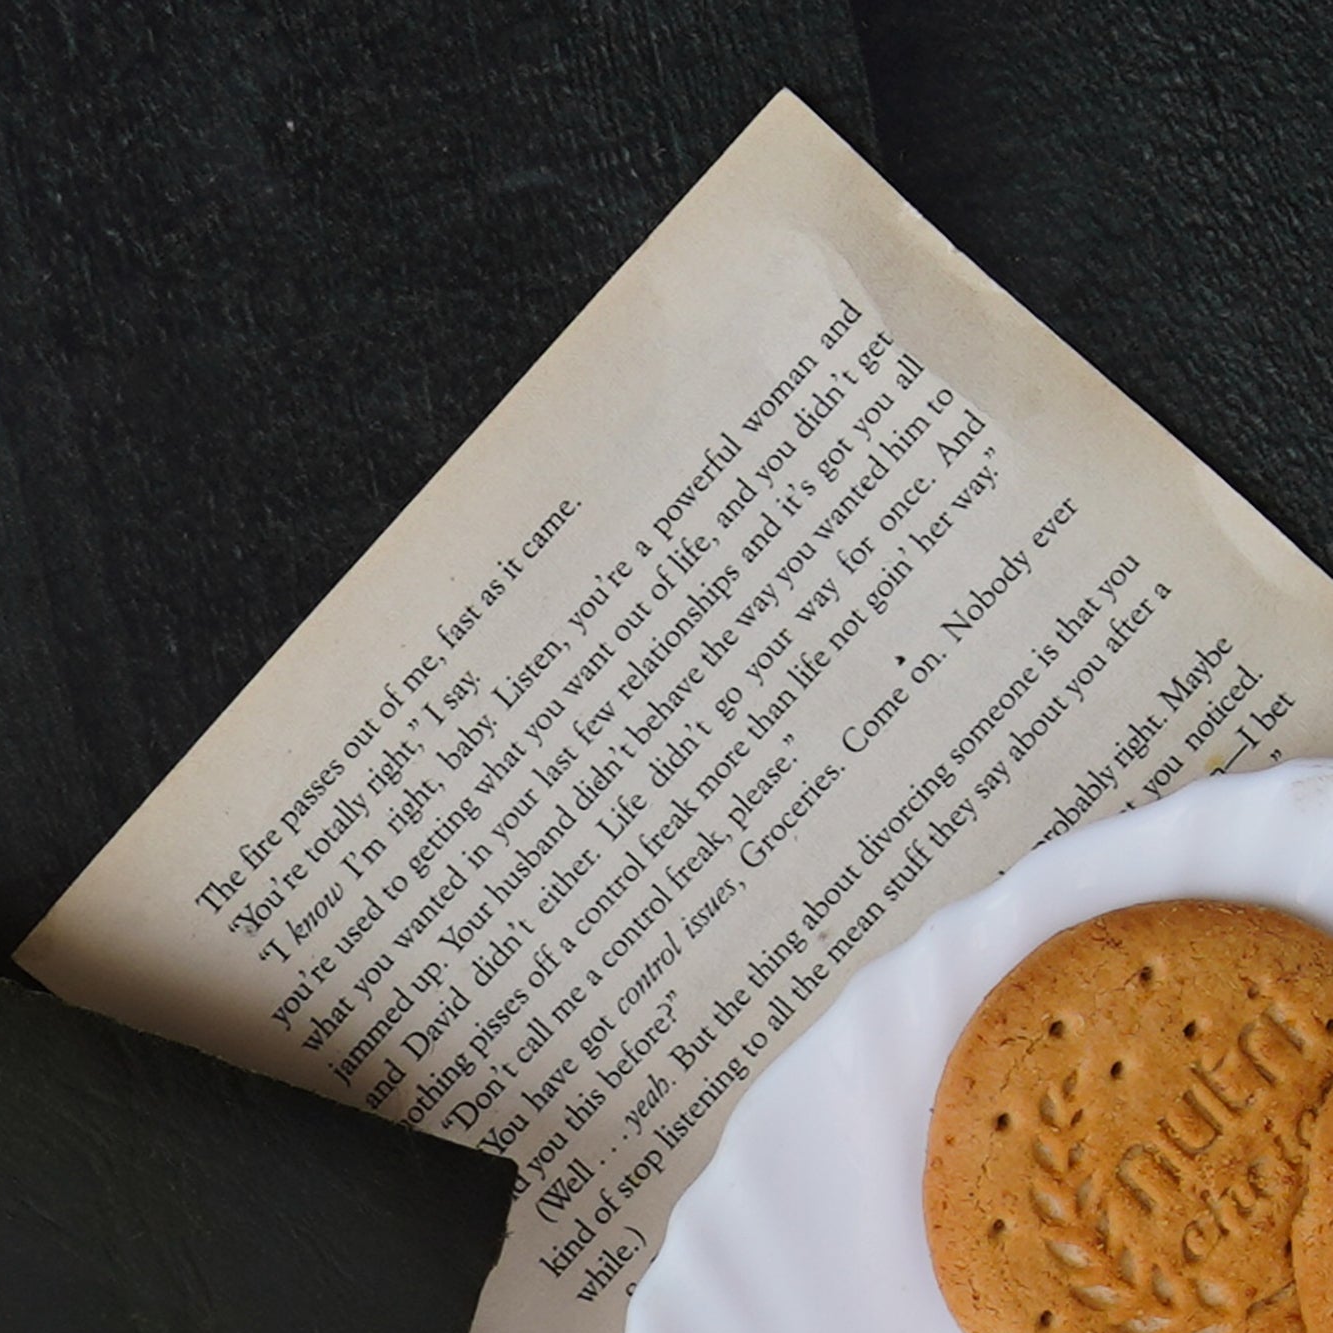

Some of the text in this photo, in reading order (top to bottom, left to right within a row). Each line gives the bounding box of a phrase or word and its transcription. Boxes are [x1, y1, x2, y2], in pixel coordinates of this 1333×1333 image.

[194, 500, 582, 914] The fire passes out of me, fast as it came.
[228, 670, 481, 934] “You’re totally right,” I say.
[258, 297, 863, 963] “I know I’m right, baby. Listen, you’re a powerful woman and
[271, 330, 895, 1031] you’re used to getting what you want out of life, and you didn’t get
[303, 353, 926, 1050] what you wanted in your last few relationships and it’s got you all
[329, 388, 954, 1085] jammed up. Your husband didn’t behave the way you wanted him to
[369, 408, 987, 1109] and David didn’t either. Life didn’t go your way for once. And
[441, 1063, 519, 1131] “Don’t
[516, 1016, 555, 1064] call
[551, 986, 587, 1024] me
[586, 969, 604, 987] a
[601, 883, 674, 968] control
[665, 831, 734, 891] freak,
[727, 733, 798, 833] please.”
[468, 988, 530, 1060] pisses
[528, 943, 562, 989] off
[559, 937, 577, 954] a
[575, 850, 648, 936] control
[638, 798, 700, 859] freak
[695, 740, 751, 801] more
[747, 689, 798, 740] than
[786, 650, 831, 691] life
[828, 609, 869, 652] not
[866, 546, 914, 616] goin’
[908, 511, 954, 554] her
[950, 446, 999, 510] way.”
[476, 1121, 530, 1155] You
[520, 1058, 579, 1113] have
[579, 1015, 617, 1061] got
[617, 930, 682, 1016] control
[680, 878, 746, 940] issues,
[739, 764, 846, 868] Groceries.
[842, 687, 910, 753] Come
[910, 653, 947, 684] on.
[940, 550, 1032, 644] Nobody
[1032, 497, 1078, 548] ever
[535, 554, 1140, 1223] (Well yeah. But the thing about divorcing someone is that you
[539, 1218, 597, 1278] kind
[594, 1187, 621, 1225] of
[617, 1149, 664, 1199] stop
[653, 1057, 750, 1150] listening
[741, 1032, 768, 1058] to
[767, 994, 797, 1032] all
[790, 963, 830, 1002] the
[826, 902, 886, 965] mean
[883, 838, 933, 902] stuff
[928, 798, 978, 848] they
[974, 760, 1011, 800] say
[1008, 695, 1070, 763] about
[1065, 653, 1108, 703] you
[1105, 598, 1156, 654] after
[1154, 583, 1172, 600] a
[1113, 714, 1167, 768] right.
[1157, 638, 1232, 712] Maybe
[1142, 664, 1263, 800] you noticed.
[1249, 692, 1295, 731] bet
[526, 989, 676, 1180] you this before?”
[576, 1226, 647, 1302] while.)
